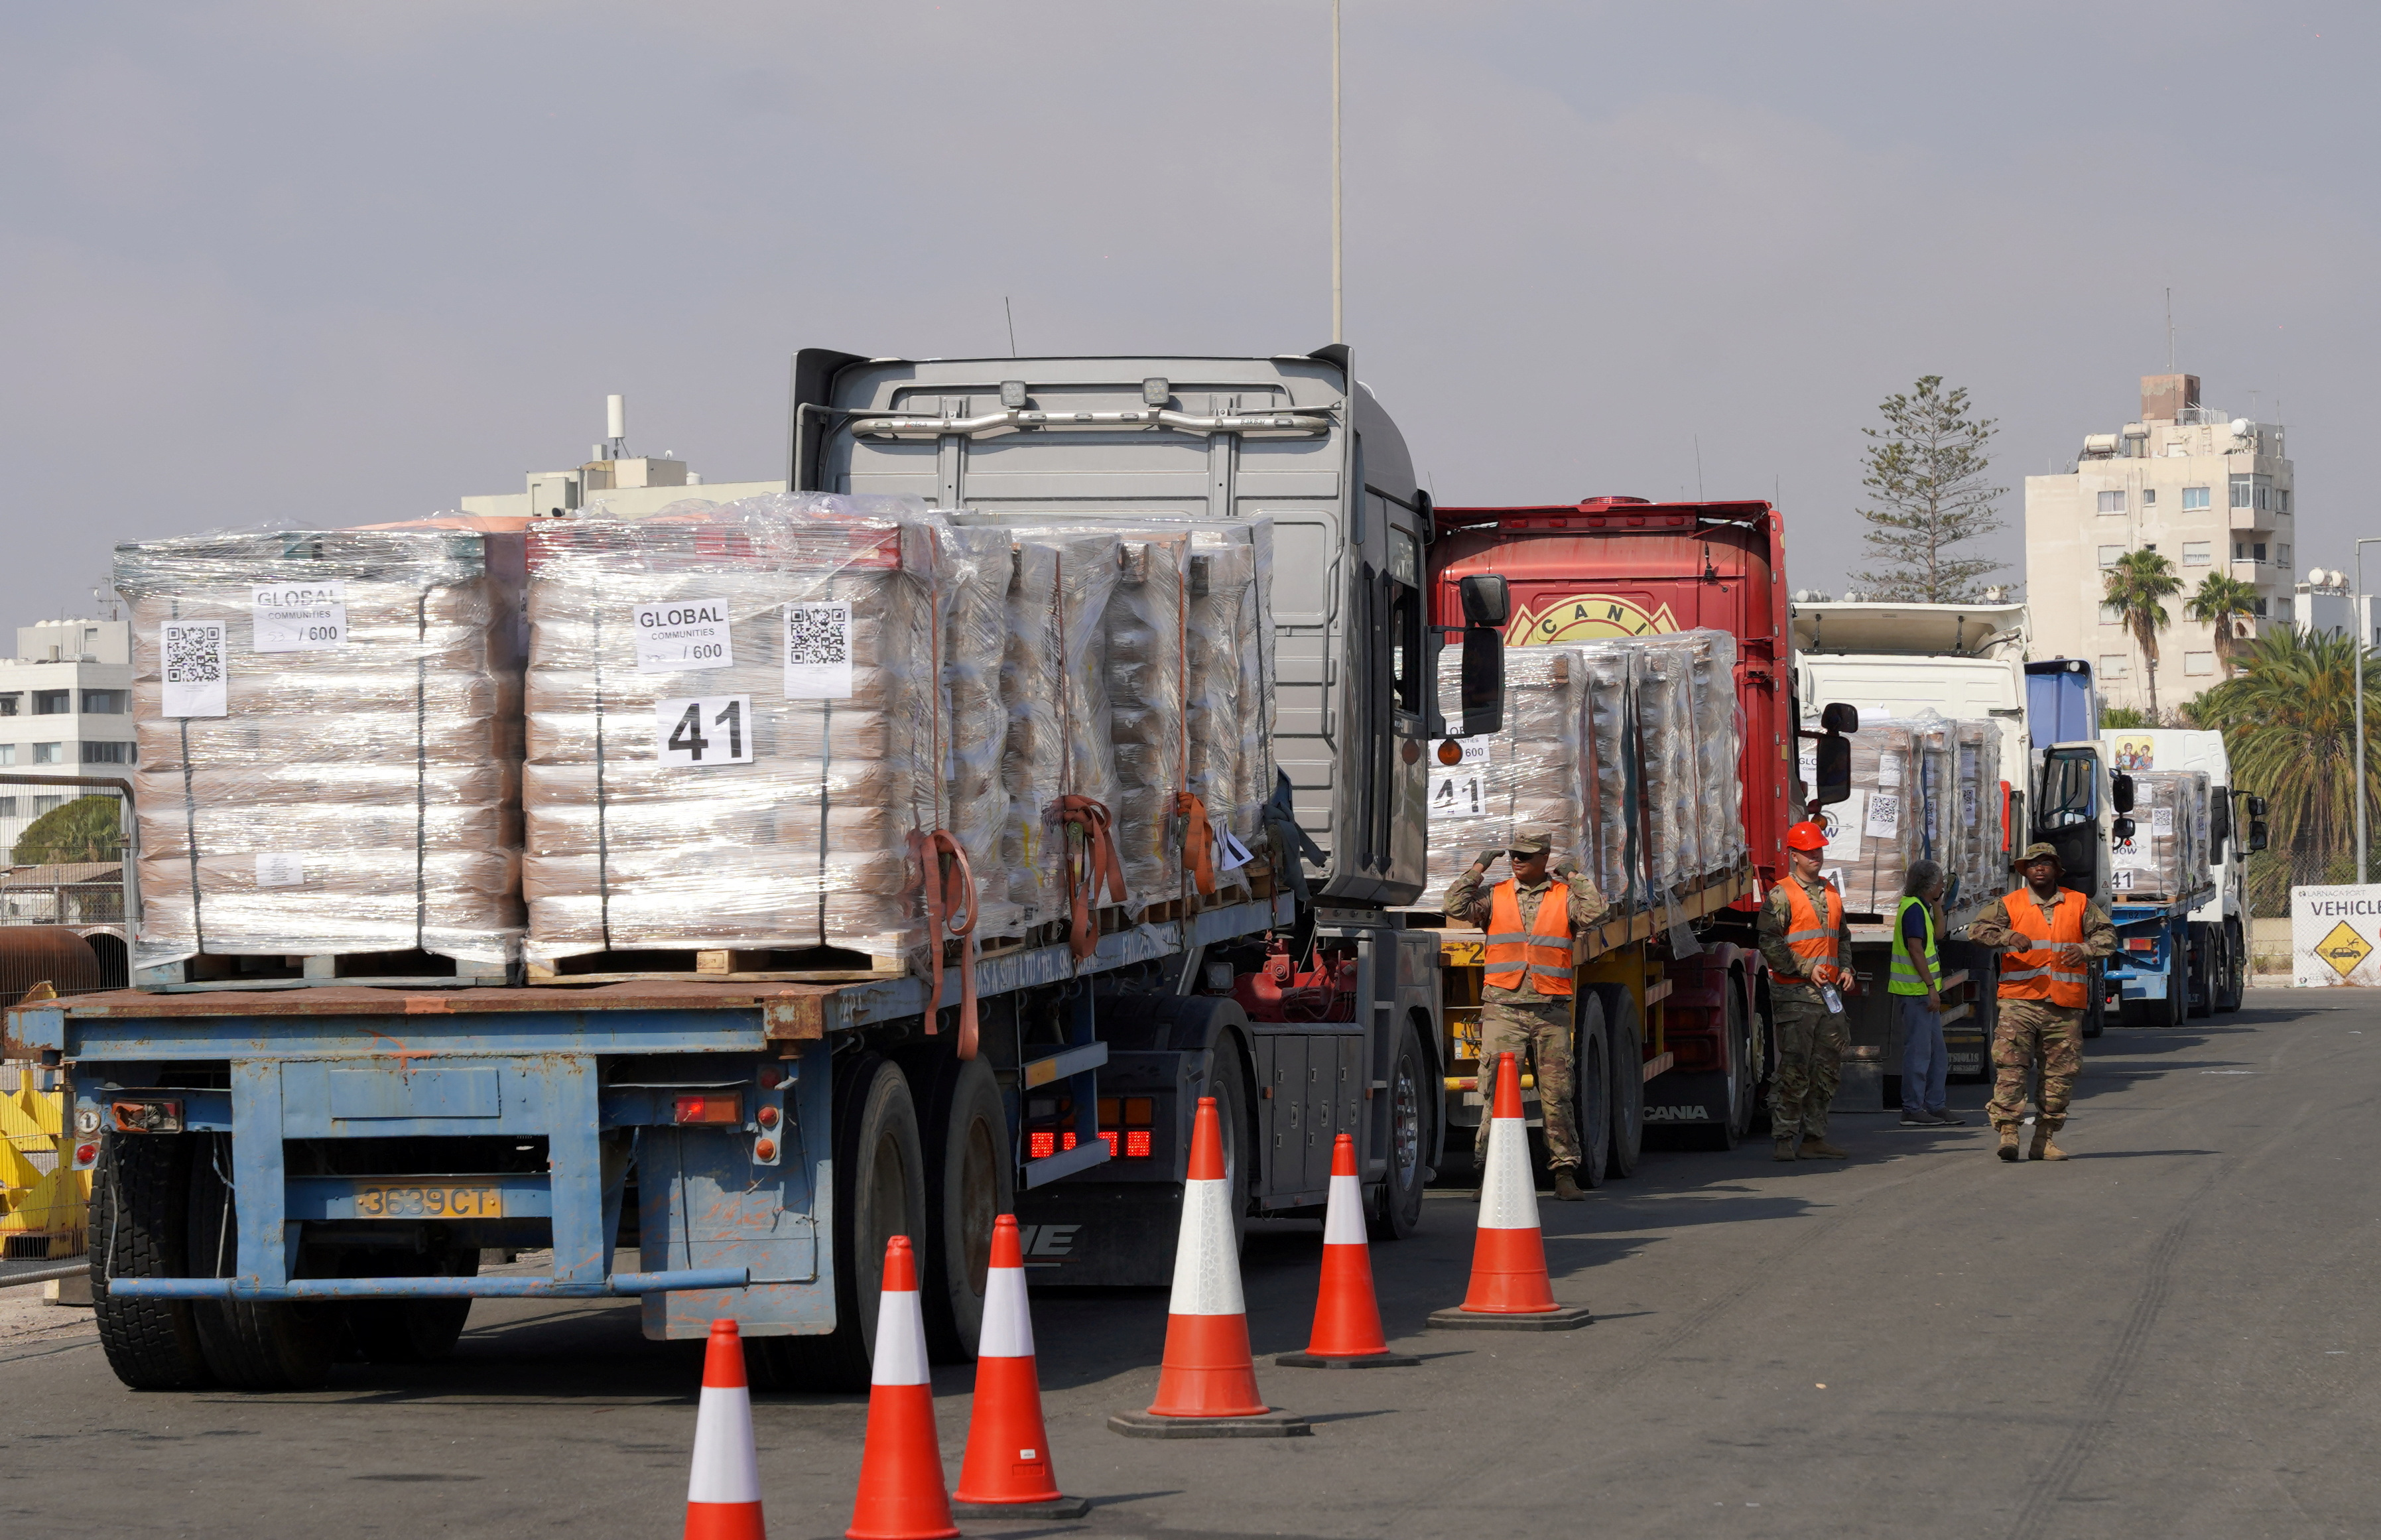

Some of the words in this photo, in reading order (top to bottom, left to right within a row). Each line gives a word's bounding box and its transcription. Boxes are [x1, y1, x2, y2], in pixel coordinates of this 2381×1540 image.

[258, 589, 340, 607] GLOBAL
[268, 610, 331, 619] COMMUNITIES
[640, 607, 724, 627] GLOBAL
[1542, 604, 1647, 635] CANI
[309, 626, 337, 641] 600
[651, 628, 714, 640] COMMUNITIES
[693, 643, 722, 659] 600
[668, 700, 741, 761] 41
[1465, 747, 1484, 757] 600
[1433, 777, 1479, 813] 41
[2112, 871, 2131, 888] 41
[1643, 1105, 1709, 1121] CANIA
